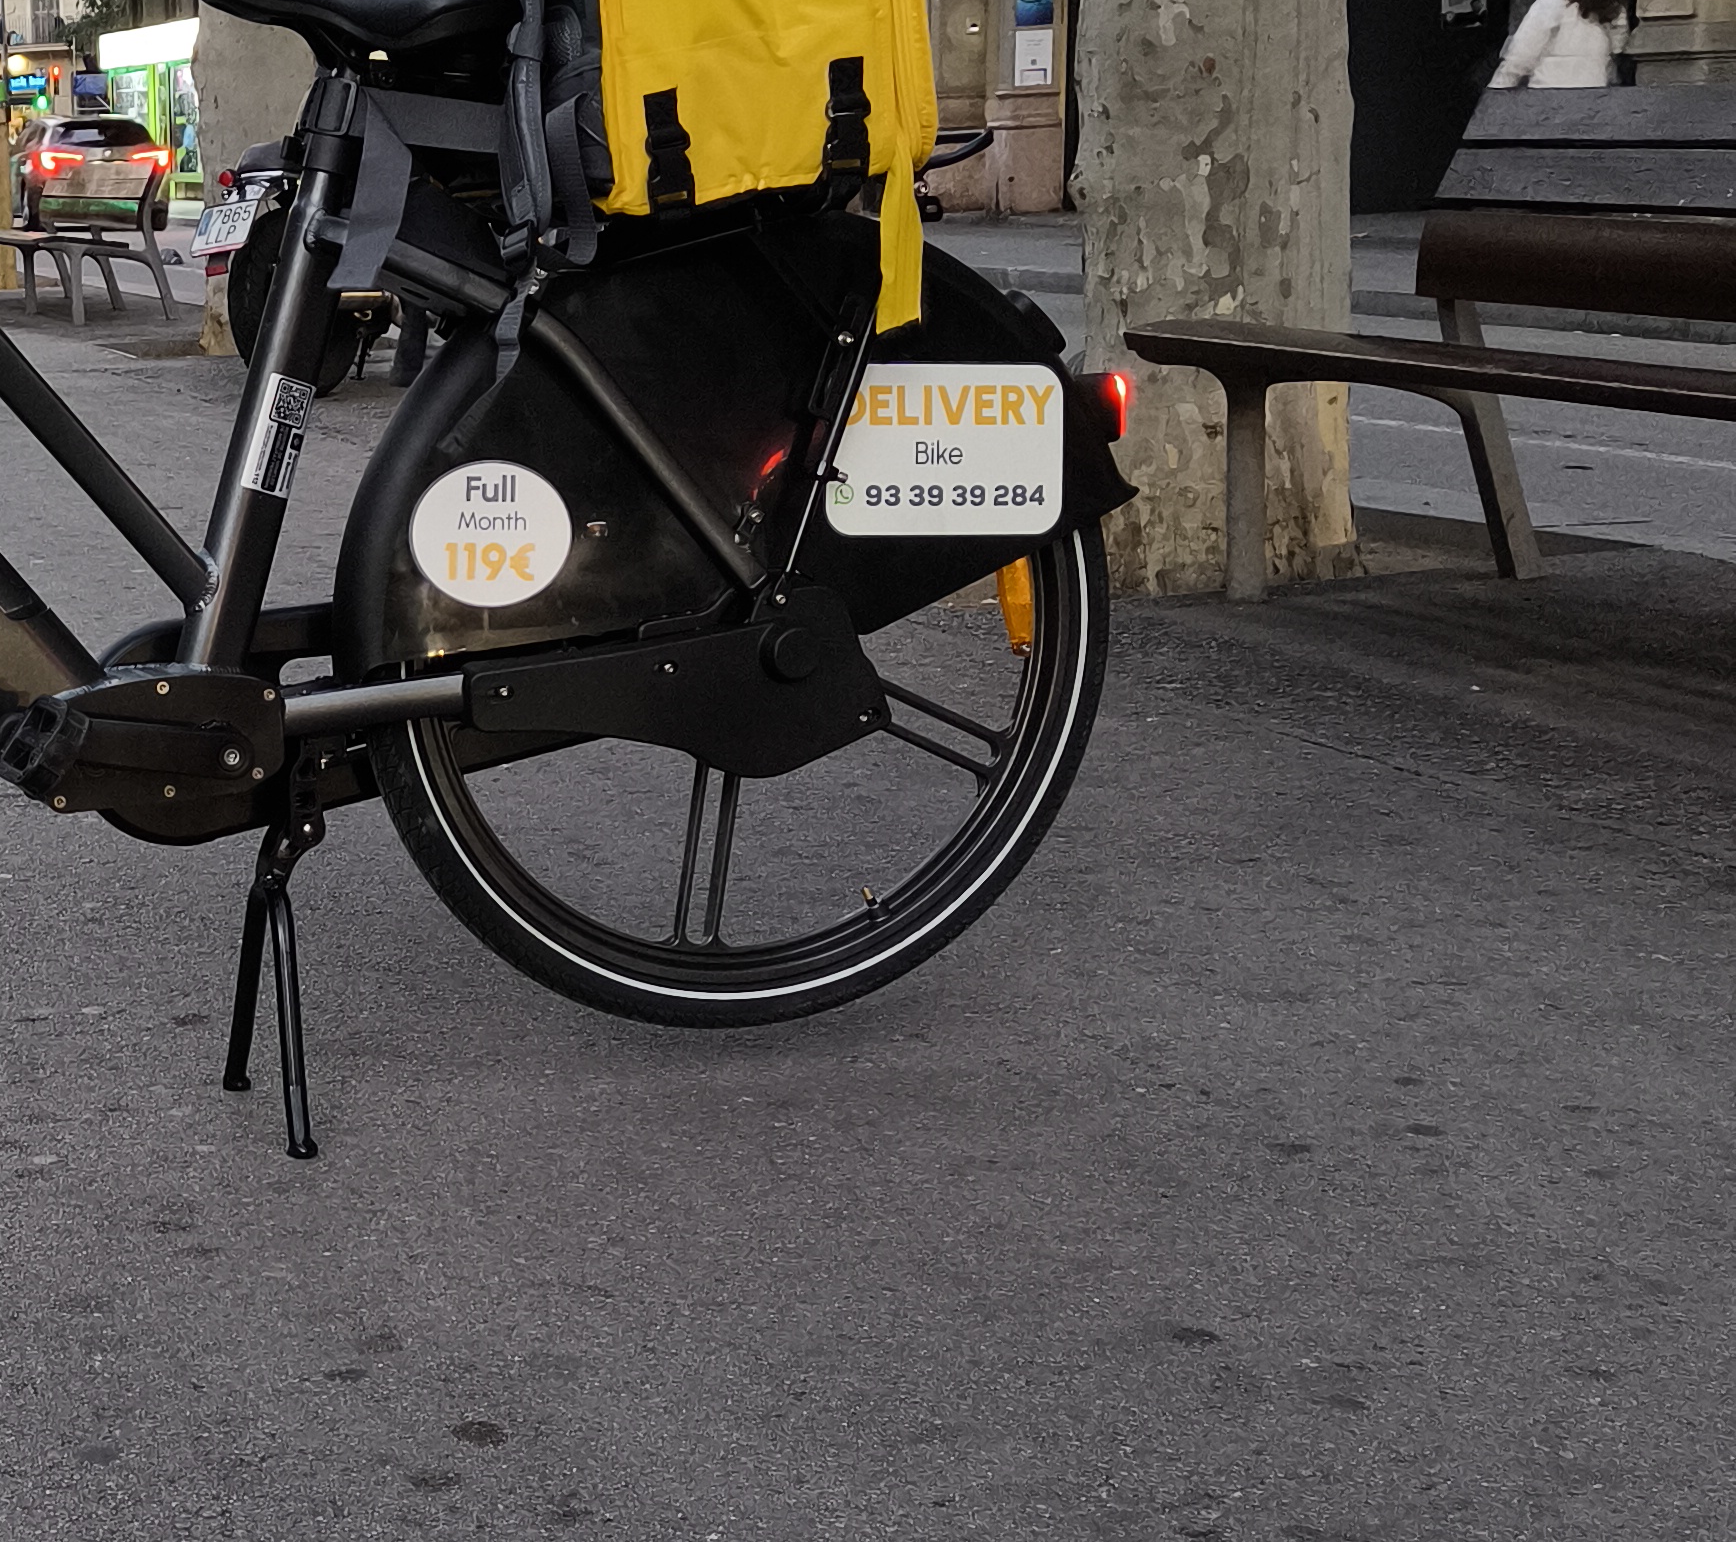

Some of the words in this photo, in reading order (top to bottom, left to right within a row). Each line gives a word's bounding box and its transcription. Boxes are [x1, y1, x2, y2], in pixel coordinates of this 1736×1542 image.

[212, 203, 255, 227] 7865
[205, 224, 237, 246] LLP
[915, 440, 964, 465] Bike
[466, 474, 517, 503] Full
[865, 484, 901, 507] 93
[908, 484, 944, 507] 39
[951, 484, 986, 507] 39
[993, 484, 1045, 506] 284
[457, 510, 527, 532] Month
[444, 542, 536, 582] 119€
